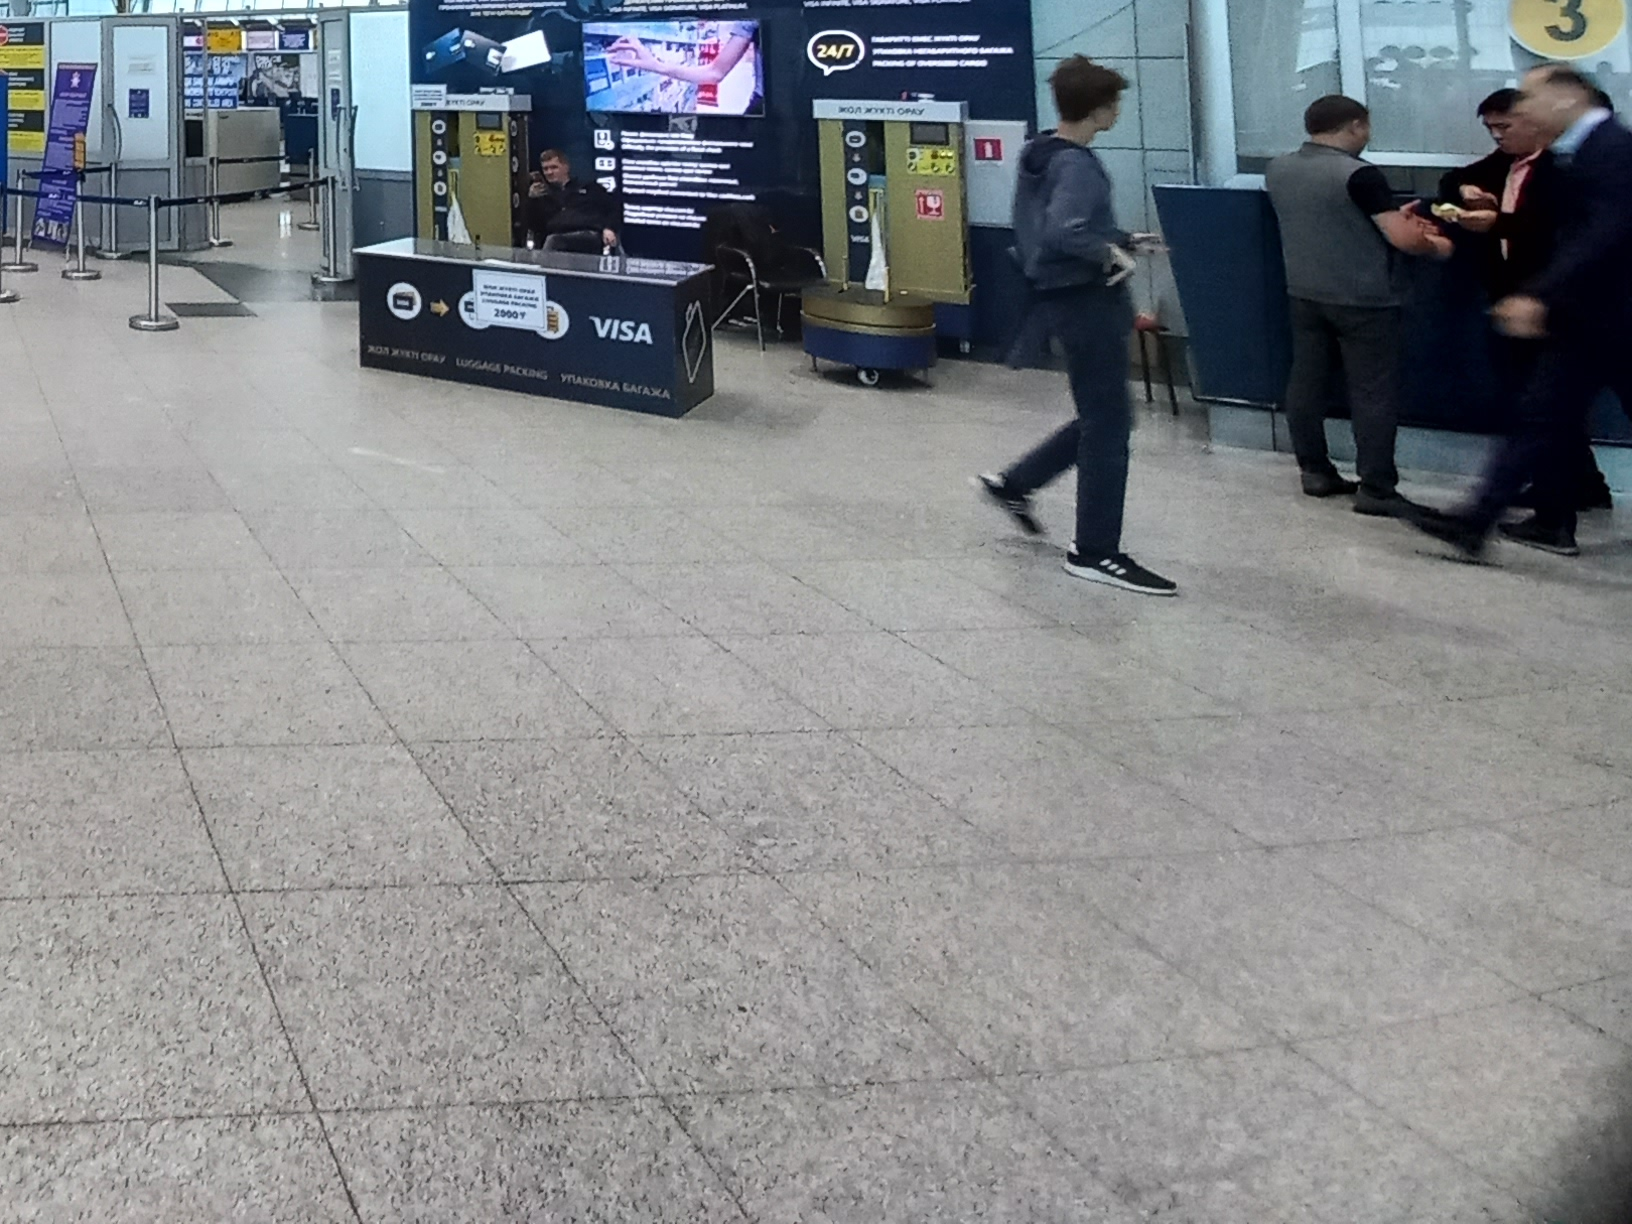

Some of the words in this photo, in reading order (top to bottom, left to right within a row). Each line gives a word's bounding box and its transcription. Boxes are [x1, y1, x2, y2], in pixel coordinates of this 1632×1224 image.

[816, 44, 855, 60] 24/7
[838, 105, 861, 116] ЖОЛ
[897, 107, 927, 116] ОРАУ
[588, 315, 653, 345] VISA
[420, 352, 447, 364] ОРАУ
[455, 357, 502, 374] LUGGAGE
[503, 364, 548, 380] PACKING
[560, 373, 620, 392] УПАКОВКА
[622, 382, 671, 400] БАГАЖА
